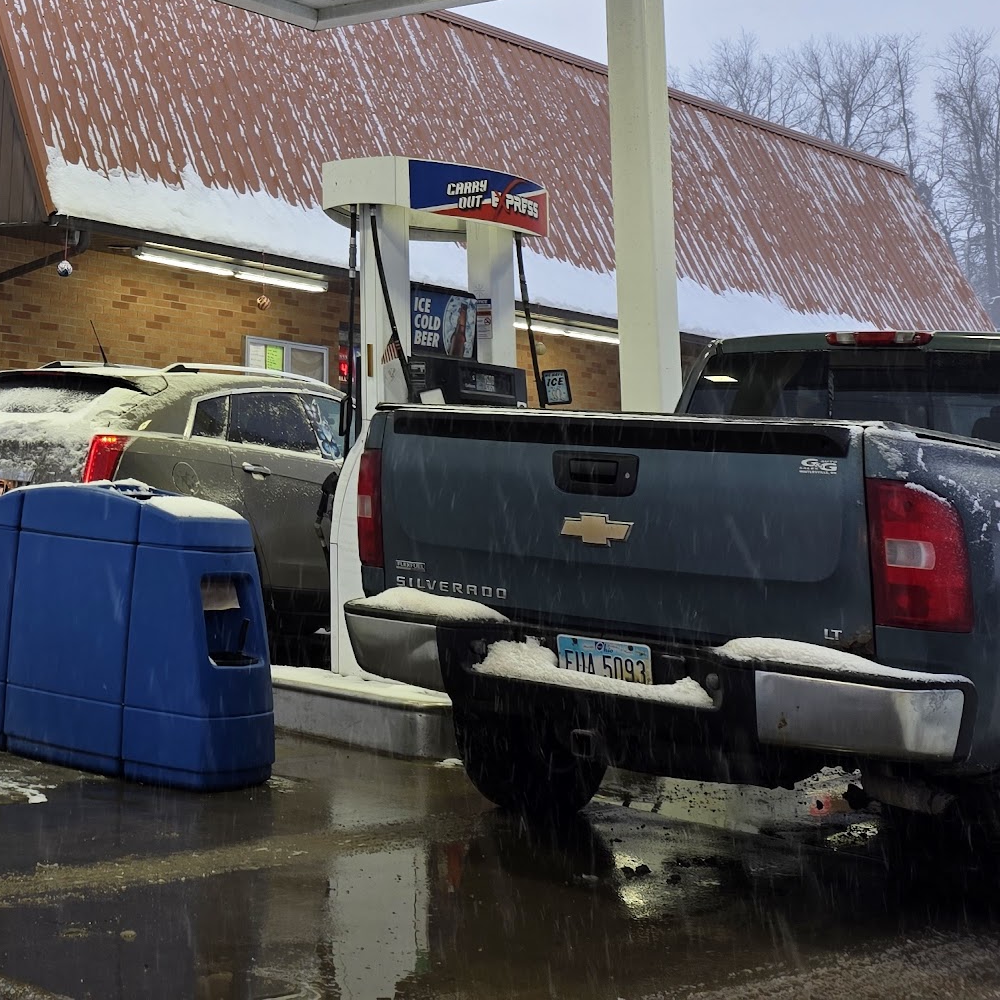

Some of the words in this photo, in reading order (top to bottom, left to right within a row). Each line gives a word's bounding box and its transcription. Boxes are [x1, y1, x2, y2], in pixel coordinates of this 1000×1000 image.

[446, 180, 488, 196] CARRY
[458, 194, 483, 209] OUT
[490, 190, 539, 219] EXPRESS
[414, 296, 431, 312] ICE
[414, 314, 441, 331] COLD
[413, 331, 439, 348] BEER
[546, 377, 563, 387] ICE
[396, 575, 507, 600] SILVERADO
[823, 628, 843, 641] LT
